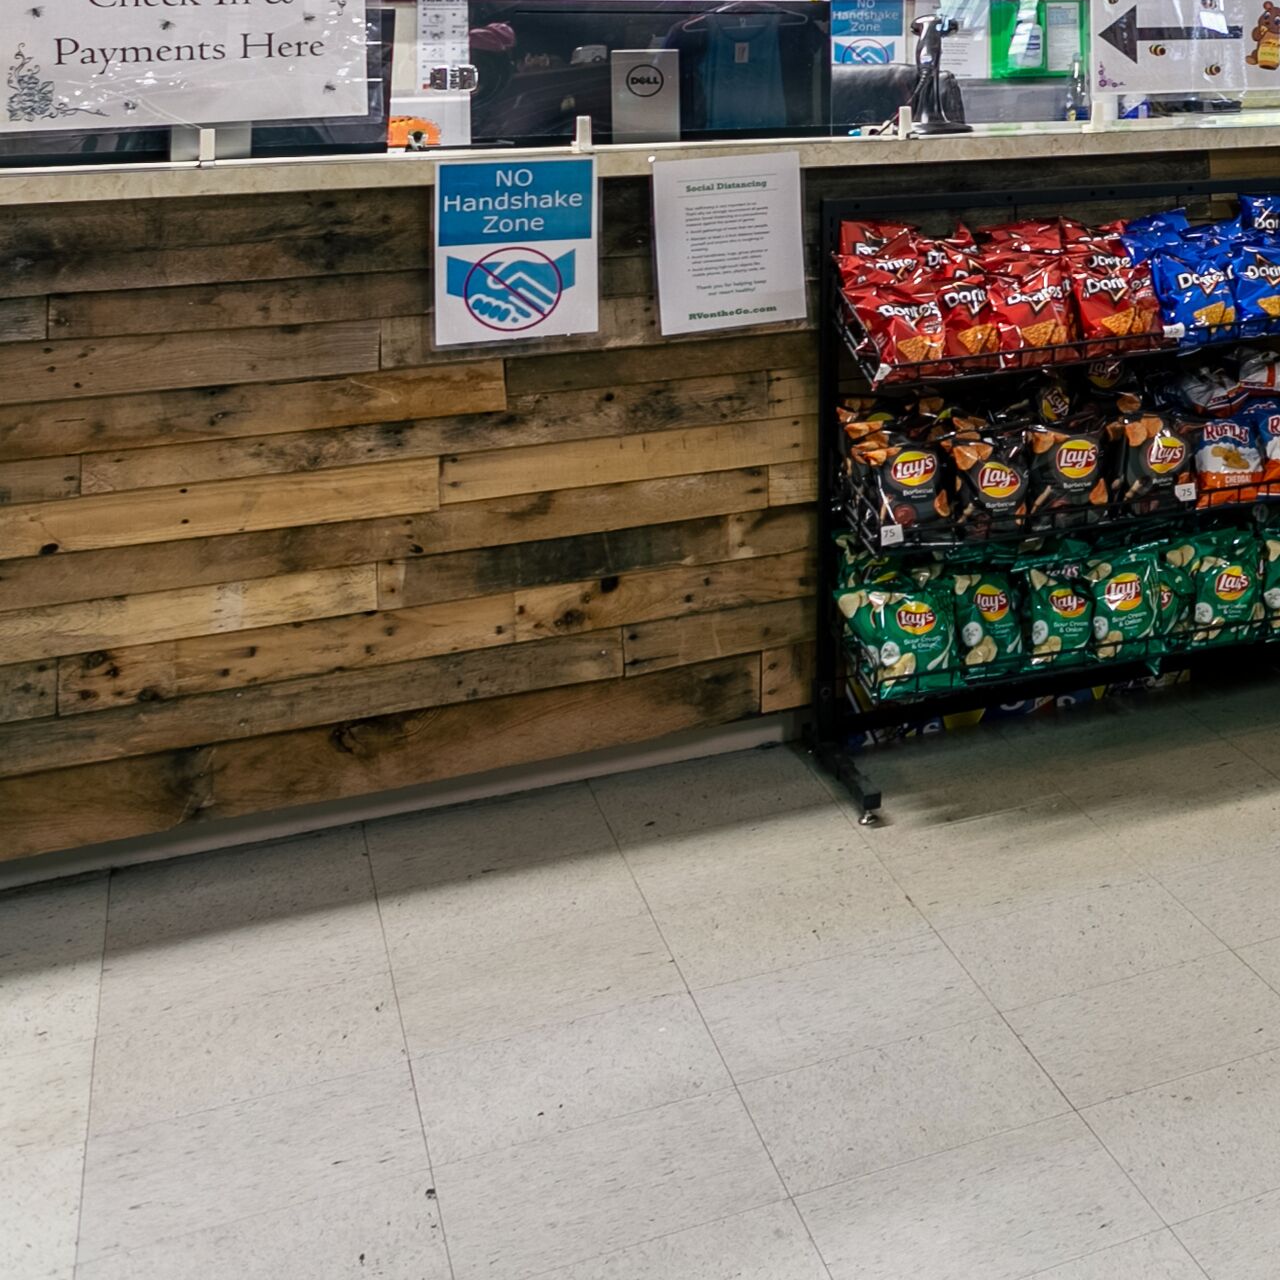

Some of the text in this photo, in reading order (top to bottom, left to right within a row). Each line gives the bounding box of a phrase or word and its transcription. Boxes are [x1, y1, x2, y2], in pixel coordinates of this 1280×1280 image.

[833, 10, 899, 21] Handshake
[851, 22, 880, 32] Zone
[54, 33, 324, 75] Payments Here
[631, 76, 660, 85] DELL
[496, 169, 533, 187] NO
[686, 180, 767, 192] Social Distancing
[444, 191, 583, 212] Handshake
[483, 216, 544, 234] Zone
[688, 306, 777, 320] RVontheGo.com
[896, 453, 934, 476] Lay's
[1059, 446, 1096, 468] Lay's
[1182, 488, 1193, 497] 75
[1106, 580, 1141, 601] Lay's
[976, 593, 1007, 612] Lay's
